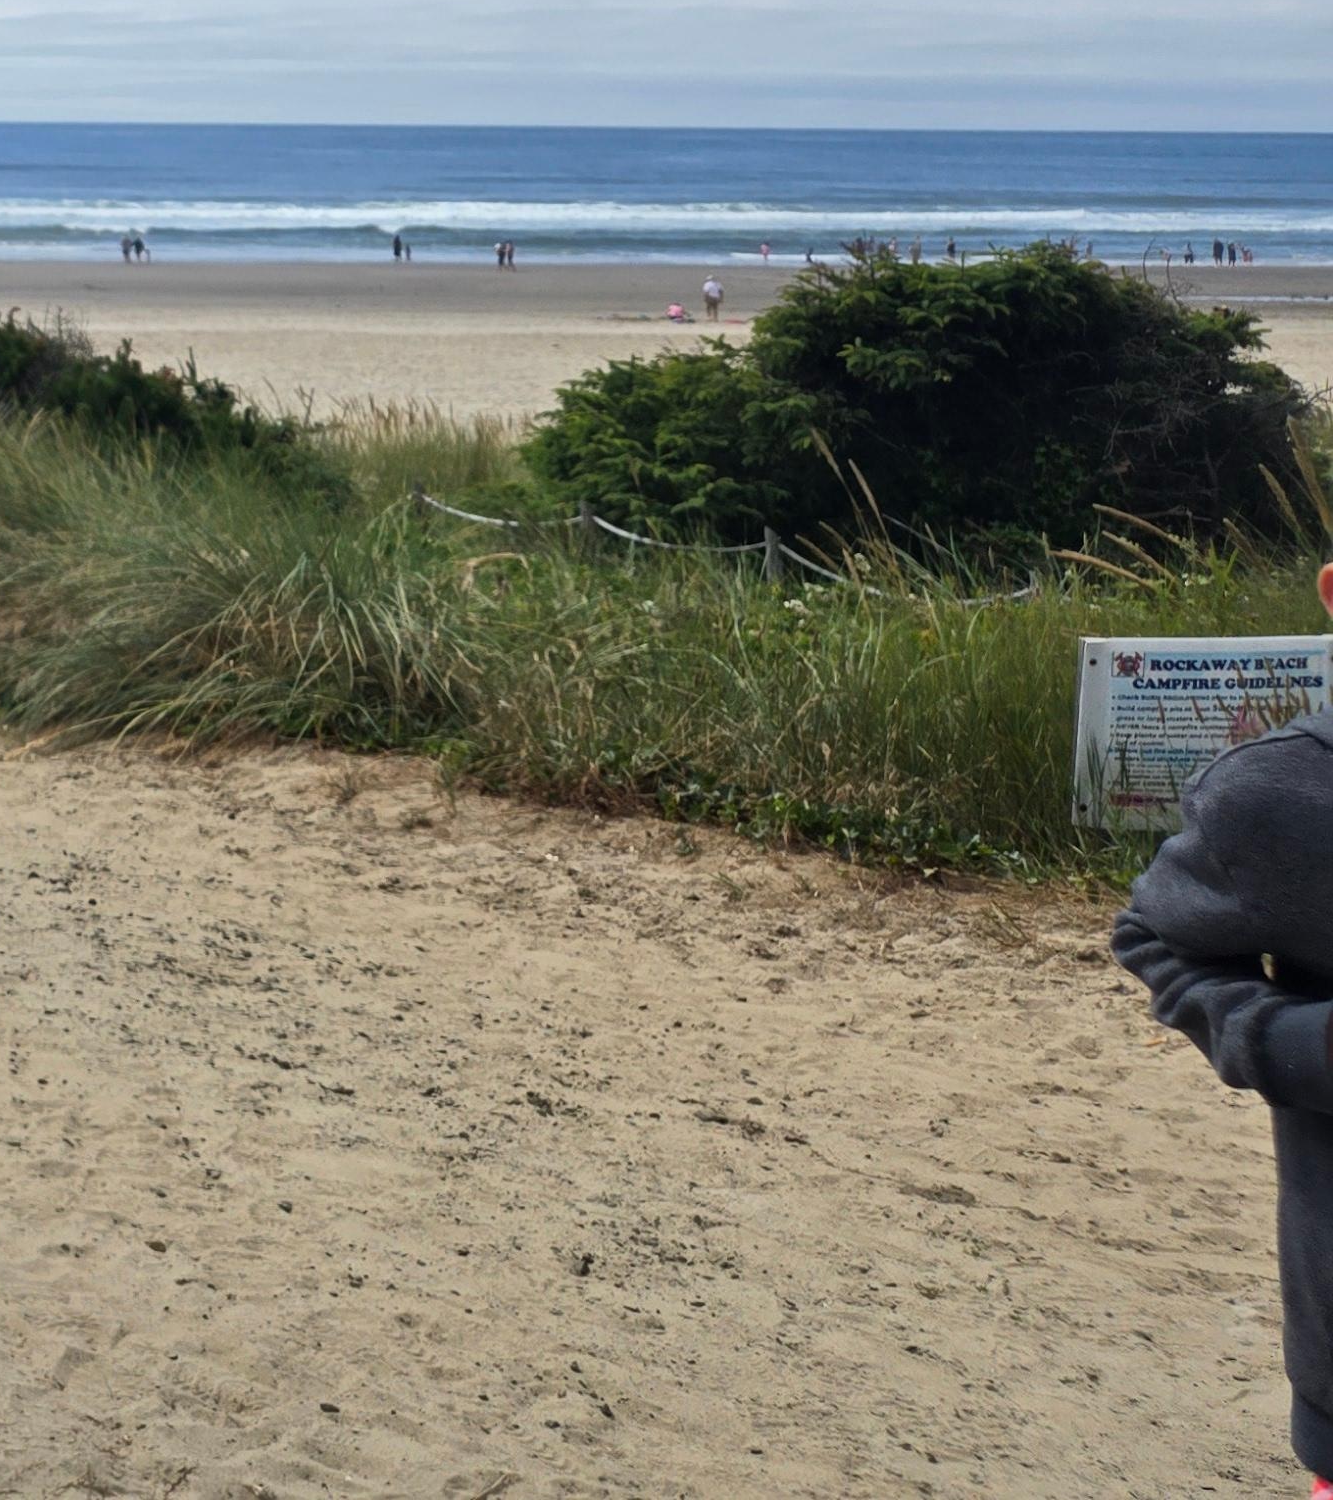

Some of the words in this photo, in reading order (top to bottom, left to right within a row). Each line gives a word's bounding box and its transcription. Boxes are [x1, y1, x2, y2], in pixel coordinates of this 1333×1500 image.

[1149, 657, 1251, 672] ROCKAWAY
[1132, 677, 1220, 690] CAMPFIRE
[1224, 675, 1324, 689] GUIDELNES
